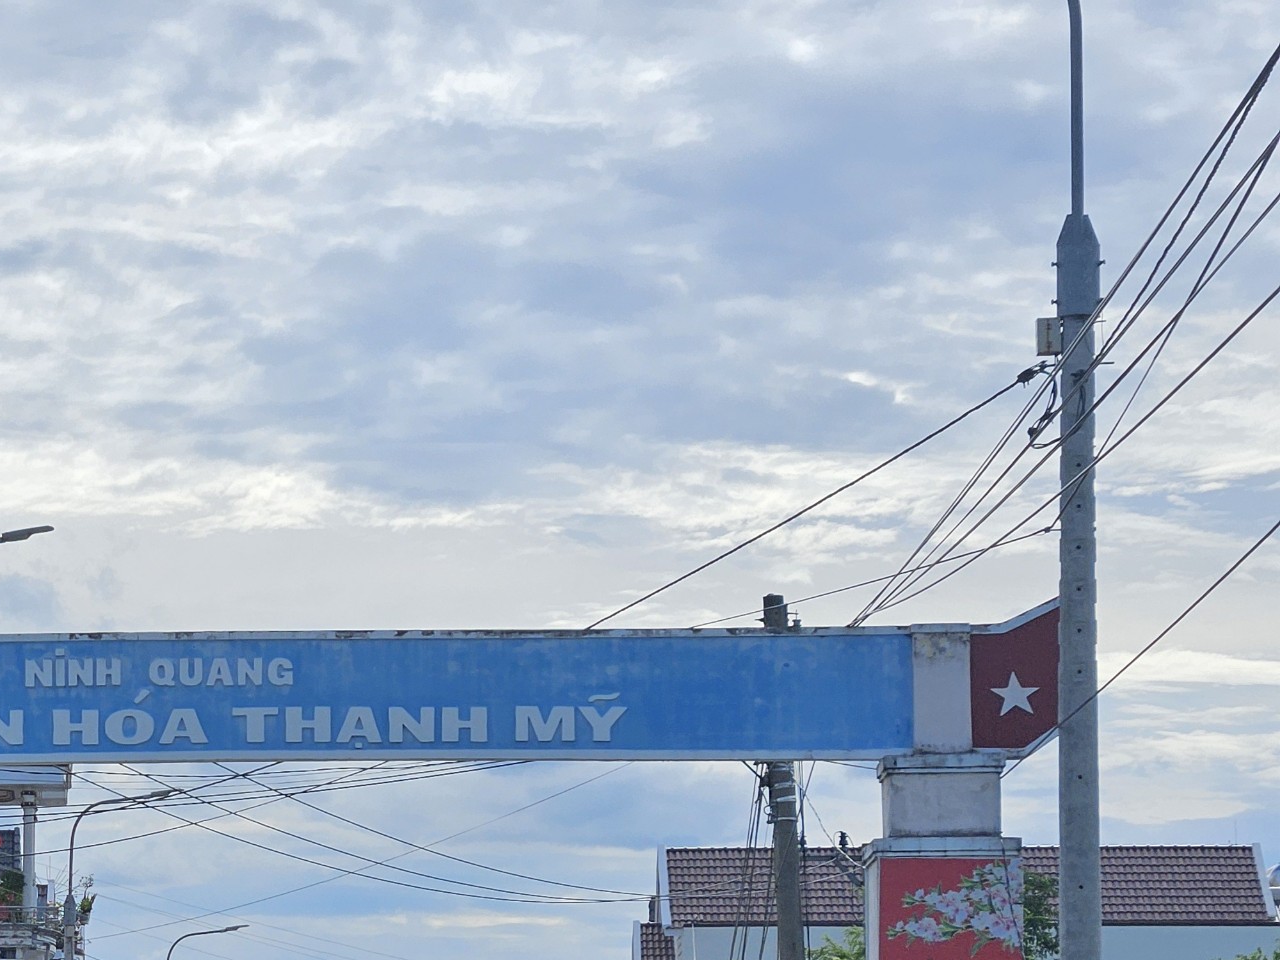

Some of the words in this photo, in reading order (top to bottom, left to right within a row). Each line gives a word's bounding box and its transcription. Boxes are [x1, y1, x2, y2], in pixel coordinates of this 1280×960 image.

[148, 657, 295, 688] QUANG
[52, 688, 209, 746] HÓA
[231, 705, 489, 749] THẠNH
[514, 692, 628, 742] MỸ
